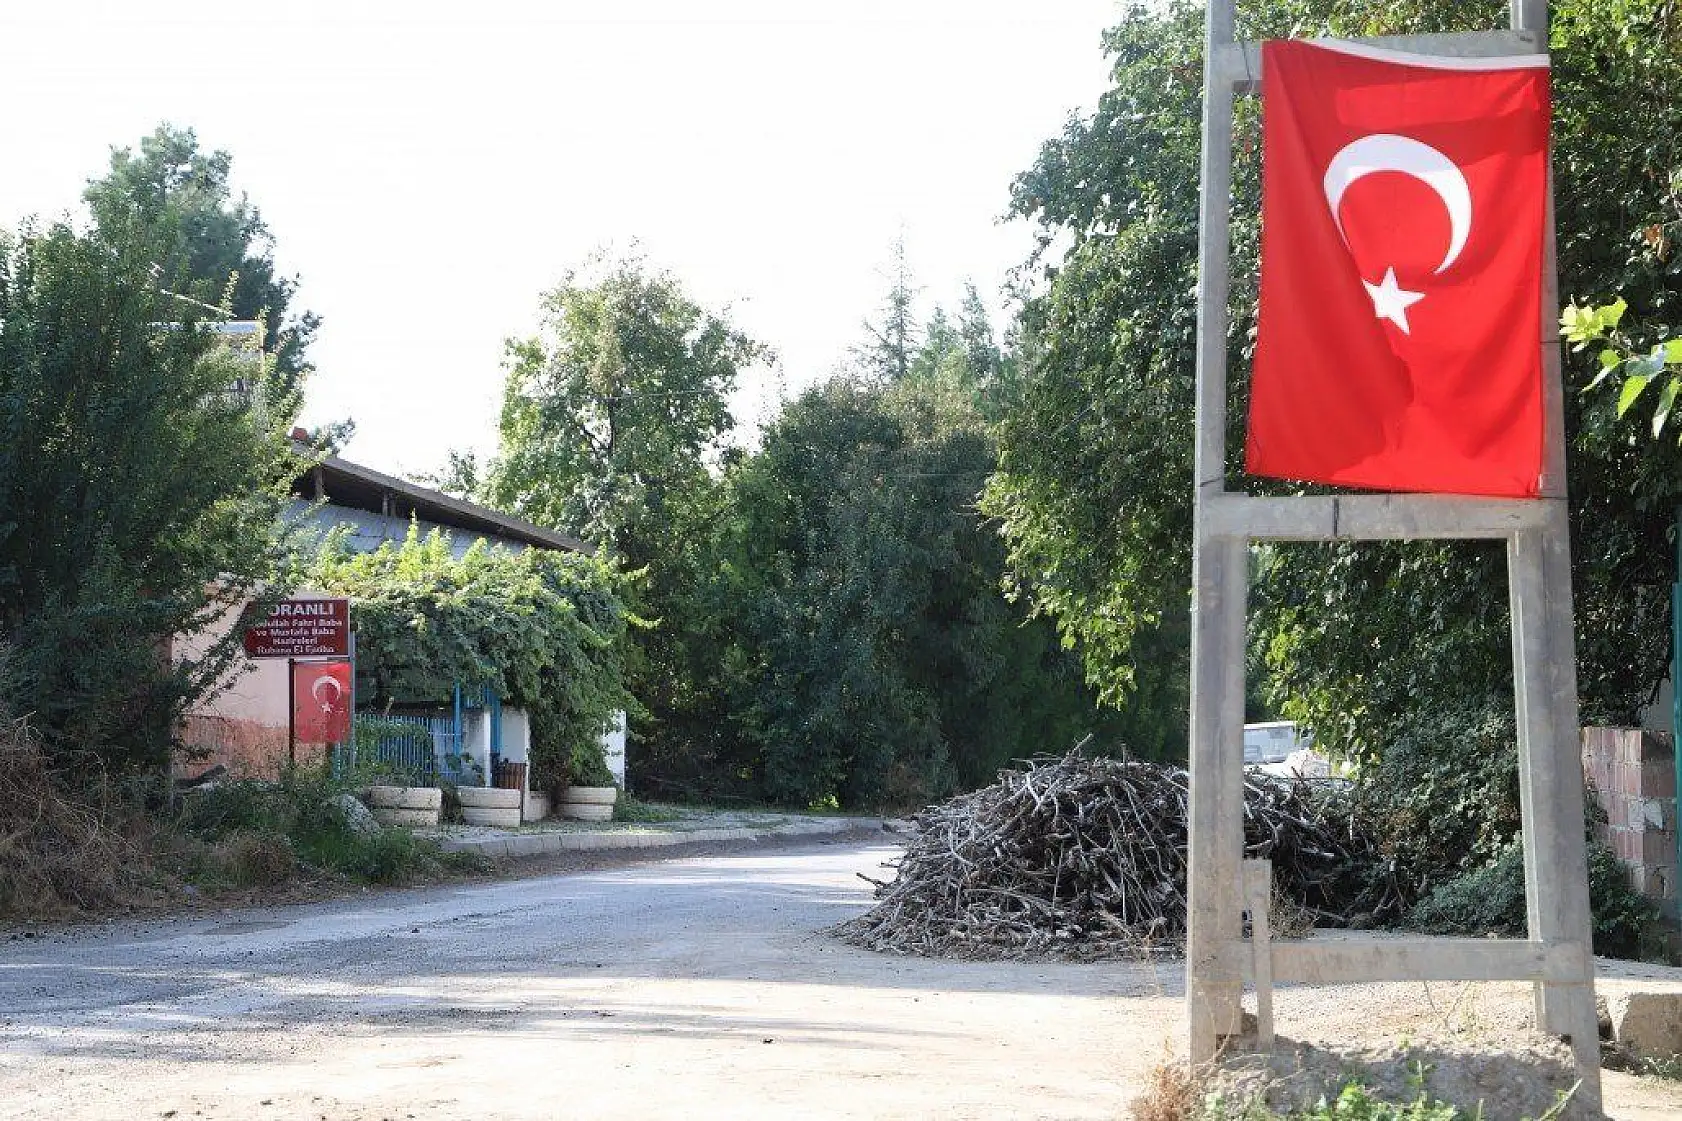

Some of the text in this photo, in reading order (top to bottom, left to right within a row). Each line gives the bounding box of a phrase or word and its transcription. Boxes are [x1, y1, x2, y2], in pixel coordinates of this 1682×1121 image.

[319, 619, 342, 627] Baba
[270, 628, 310, 636] Mustafa
[312, 627, 335, 635] Baba
[293, 645, 303, 653] El
